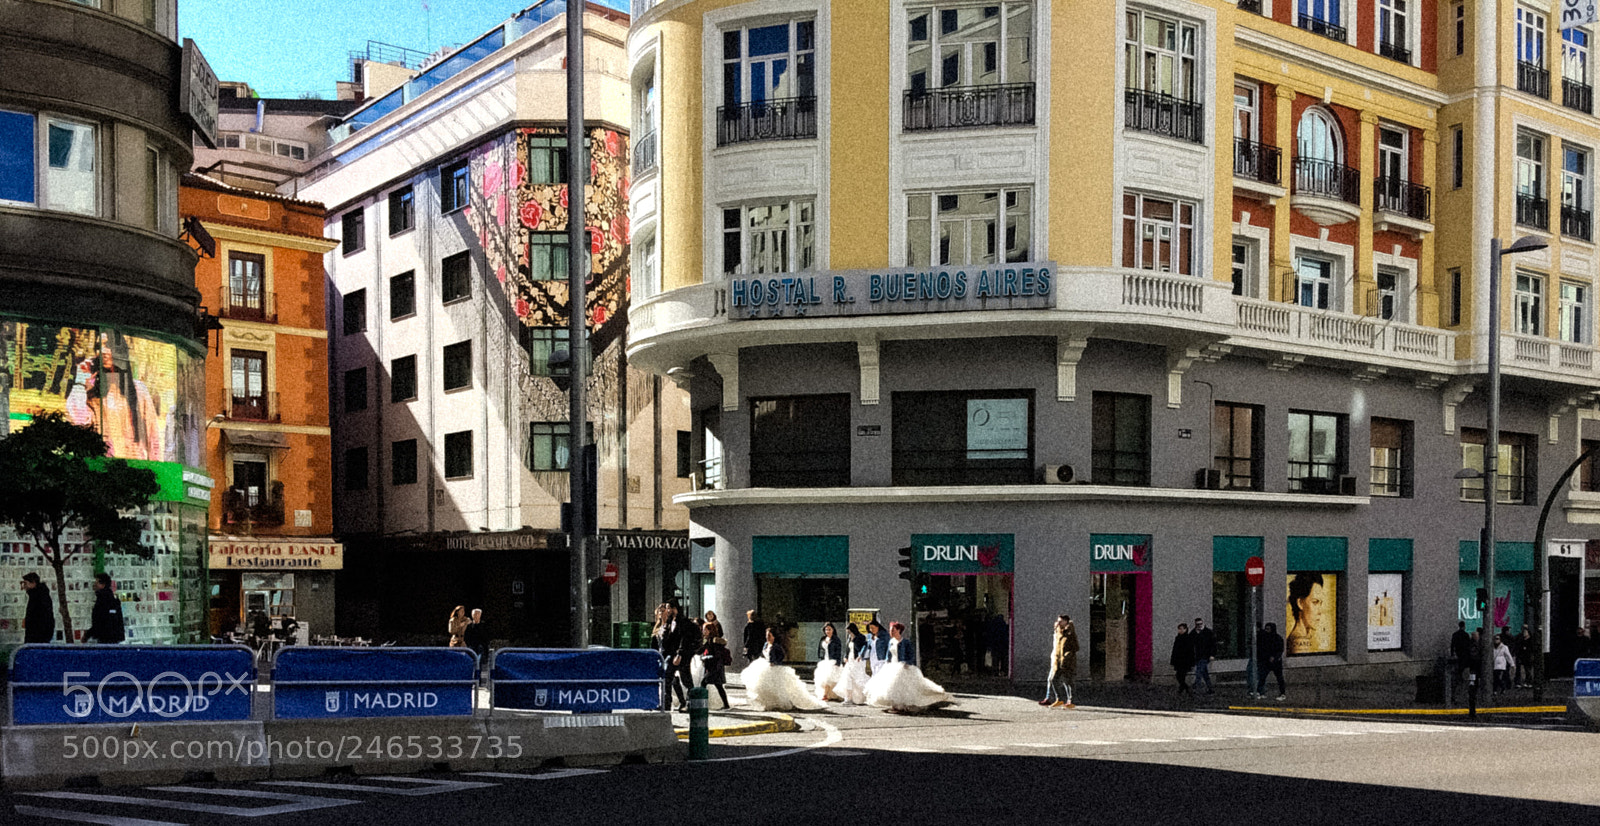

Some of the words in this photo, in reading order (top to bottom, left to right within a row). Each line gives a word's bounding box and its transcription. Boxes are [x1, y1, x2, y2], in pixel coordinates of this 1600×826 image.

[731, 277, 822, 307] HOSTAL
[833, 275, 855, 303] R.
[869, 270, 968, 301] BUENOS
[976, 267, 1051, 298] AIRES
[446, 537, 474, 550] HOTEL
[1560, 544, 1571, 555] 61
[924, 545, 978, 561] DRUNI
[1094, 544, 1133, 560] DRUNI
[226, 556, 321, 568] Restaurante
[109, 695, 209, 714] MADRID
[353, 692, 439, 710] MADRID
[558, 688, 631, 705] MADRID
